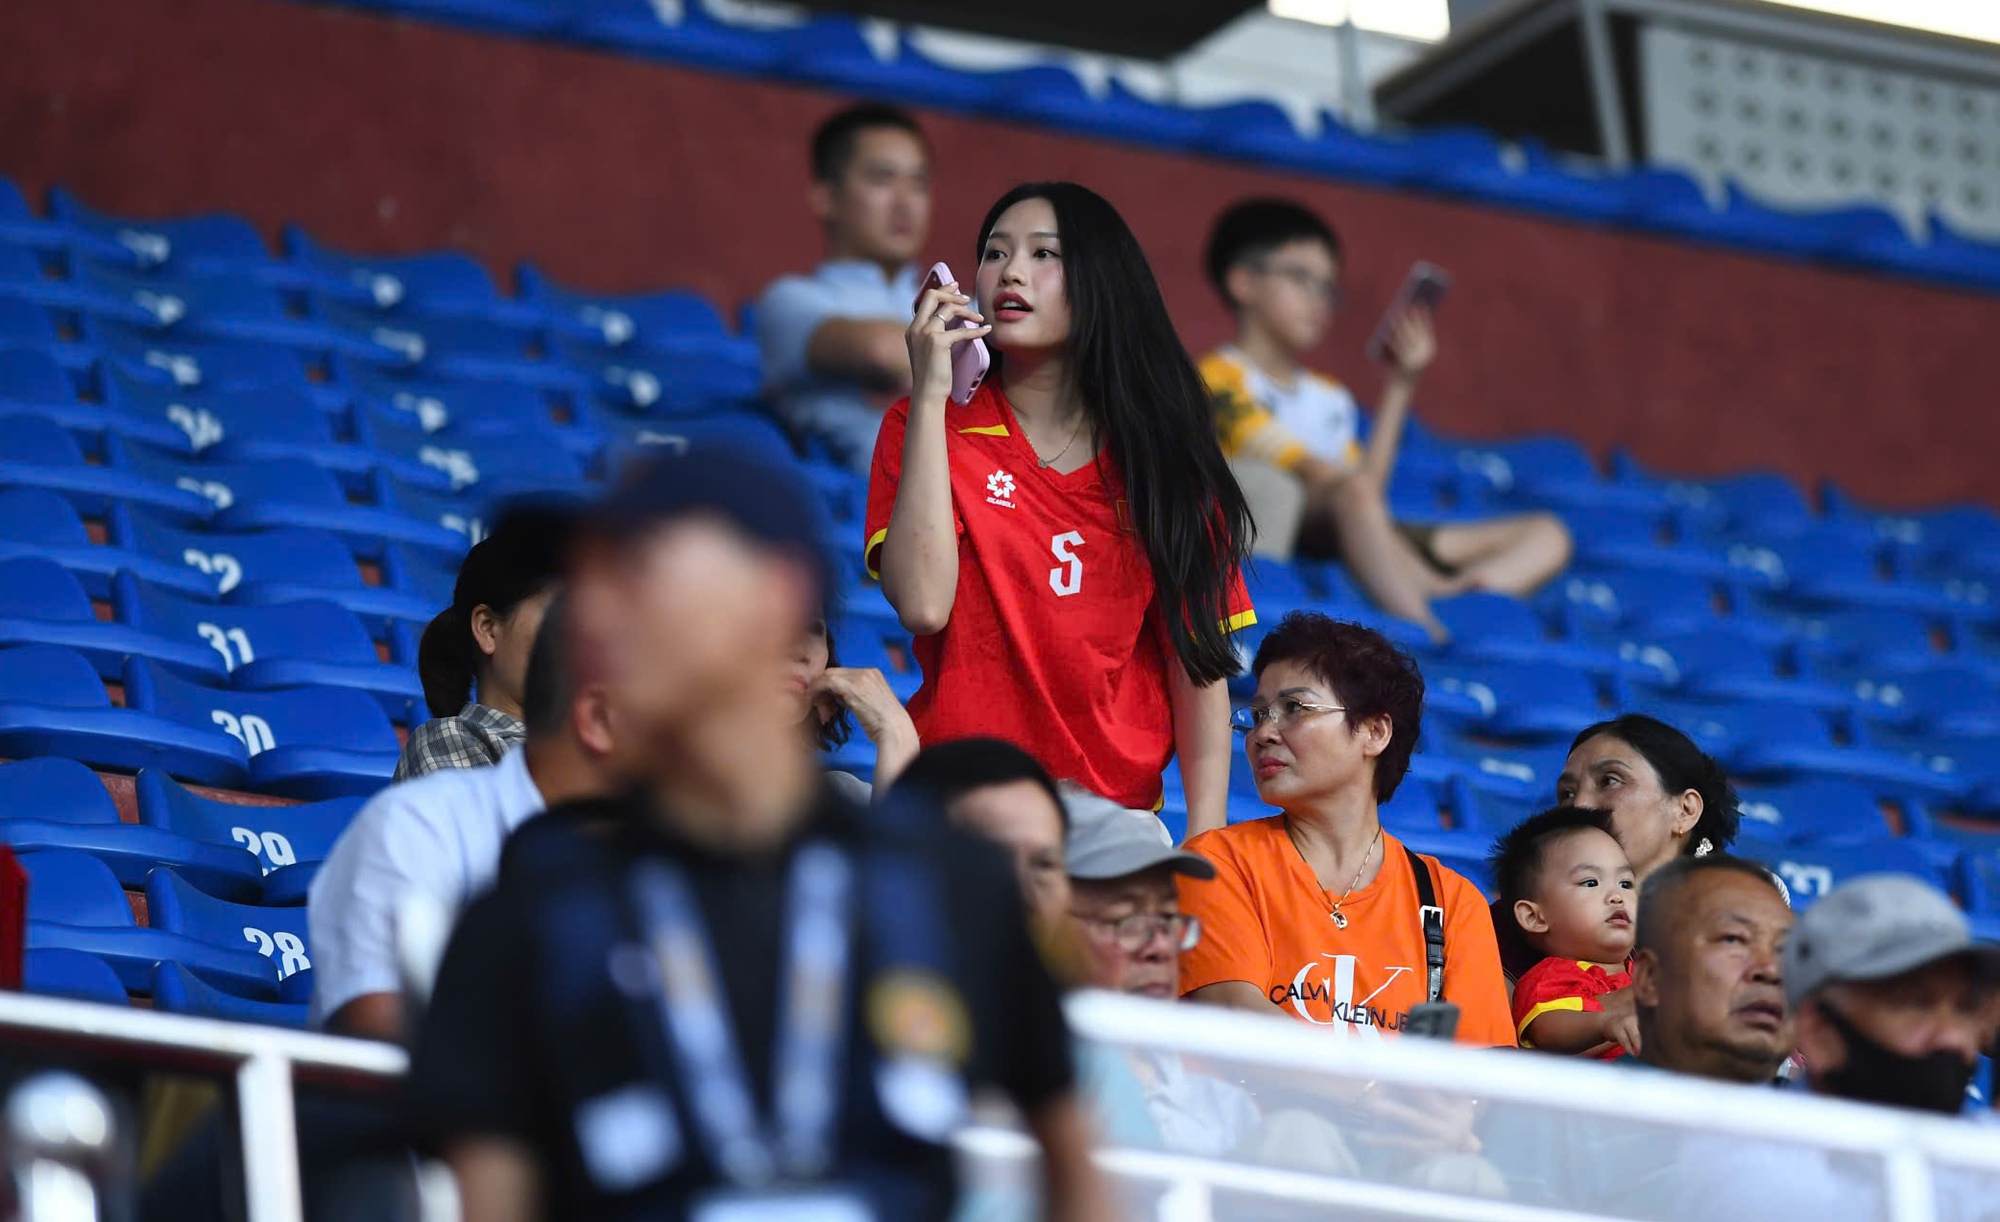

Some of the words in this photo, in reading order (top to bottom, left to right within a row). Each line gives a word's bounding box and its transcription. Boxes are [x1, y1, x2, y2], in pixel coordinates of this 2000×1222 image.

[231, 826, 296, 877] 29
[243, 926, 311, 982] 28
[1332, 999, 1386, 1028] KLEIN
